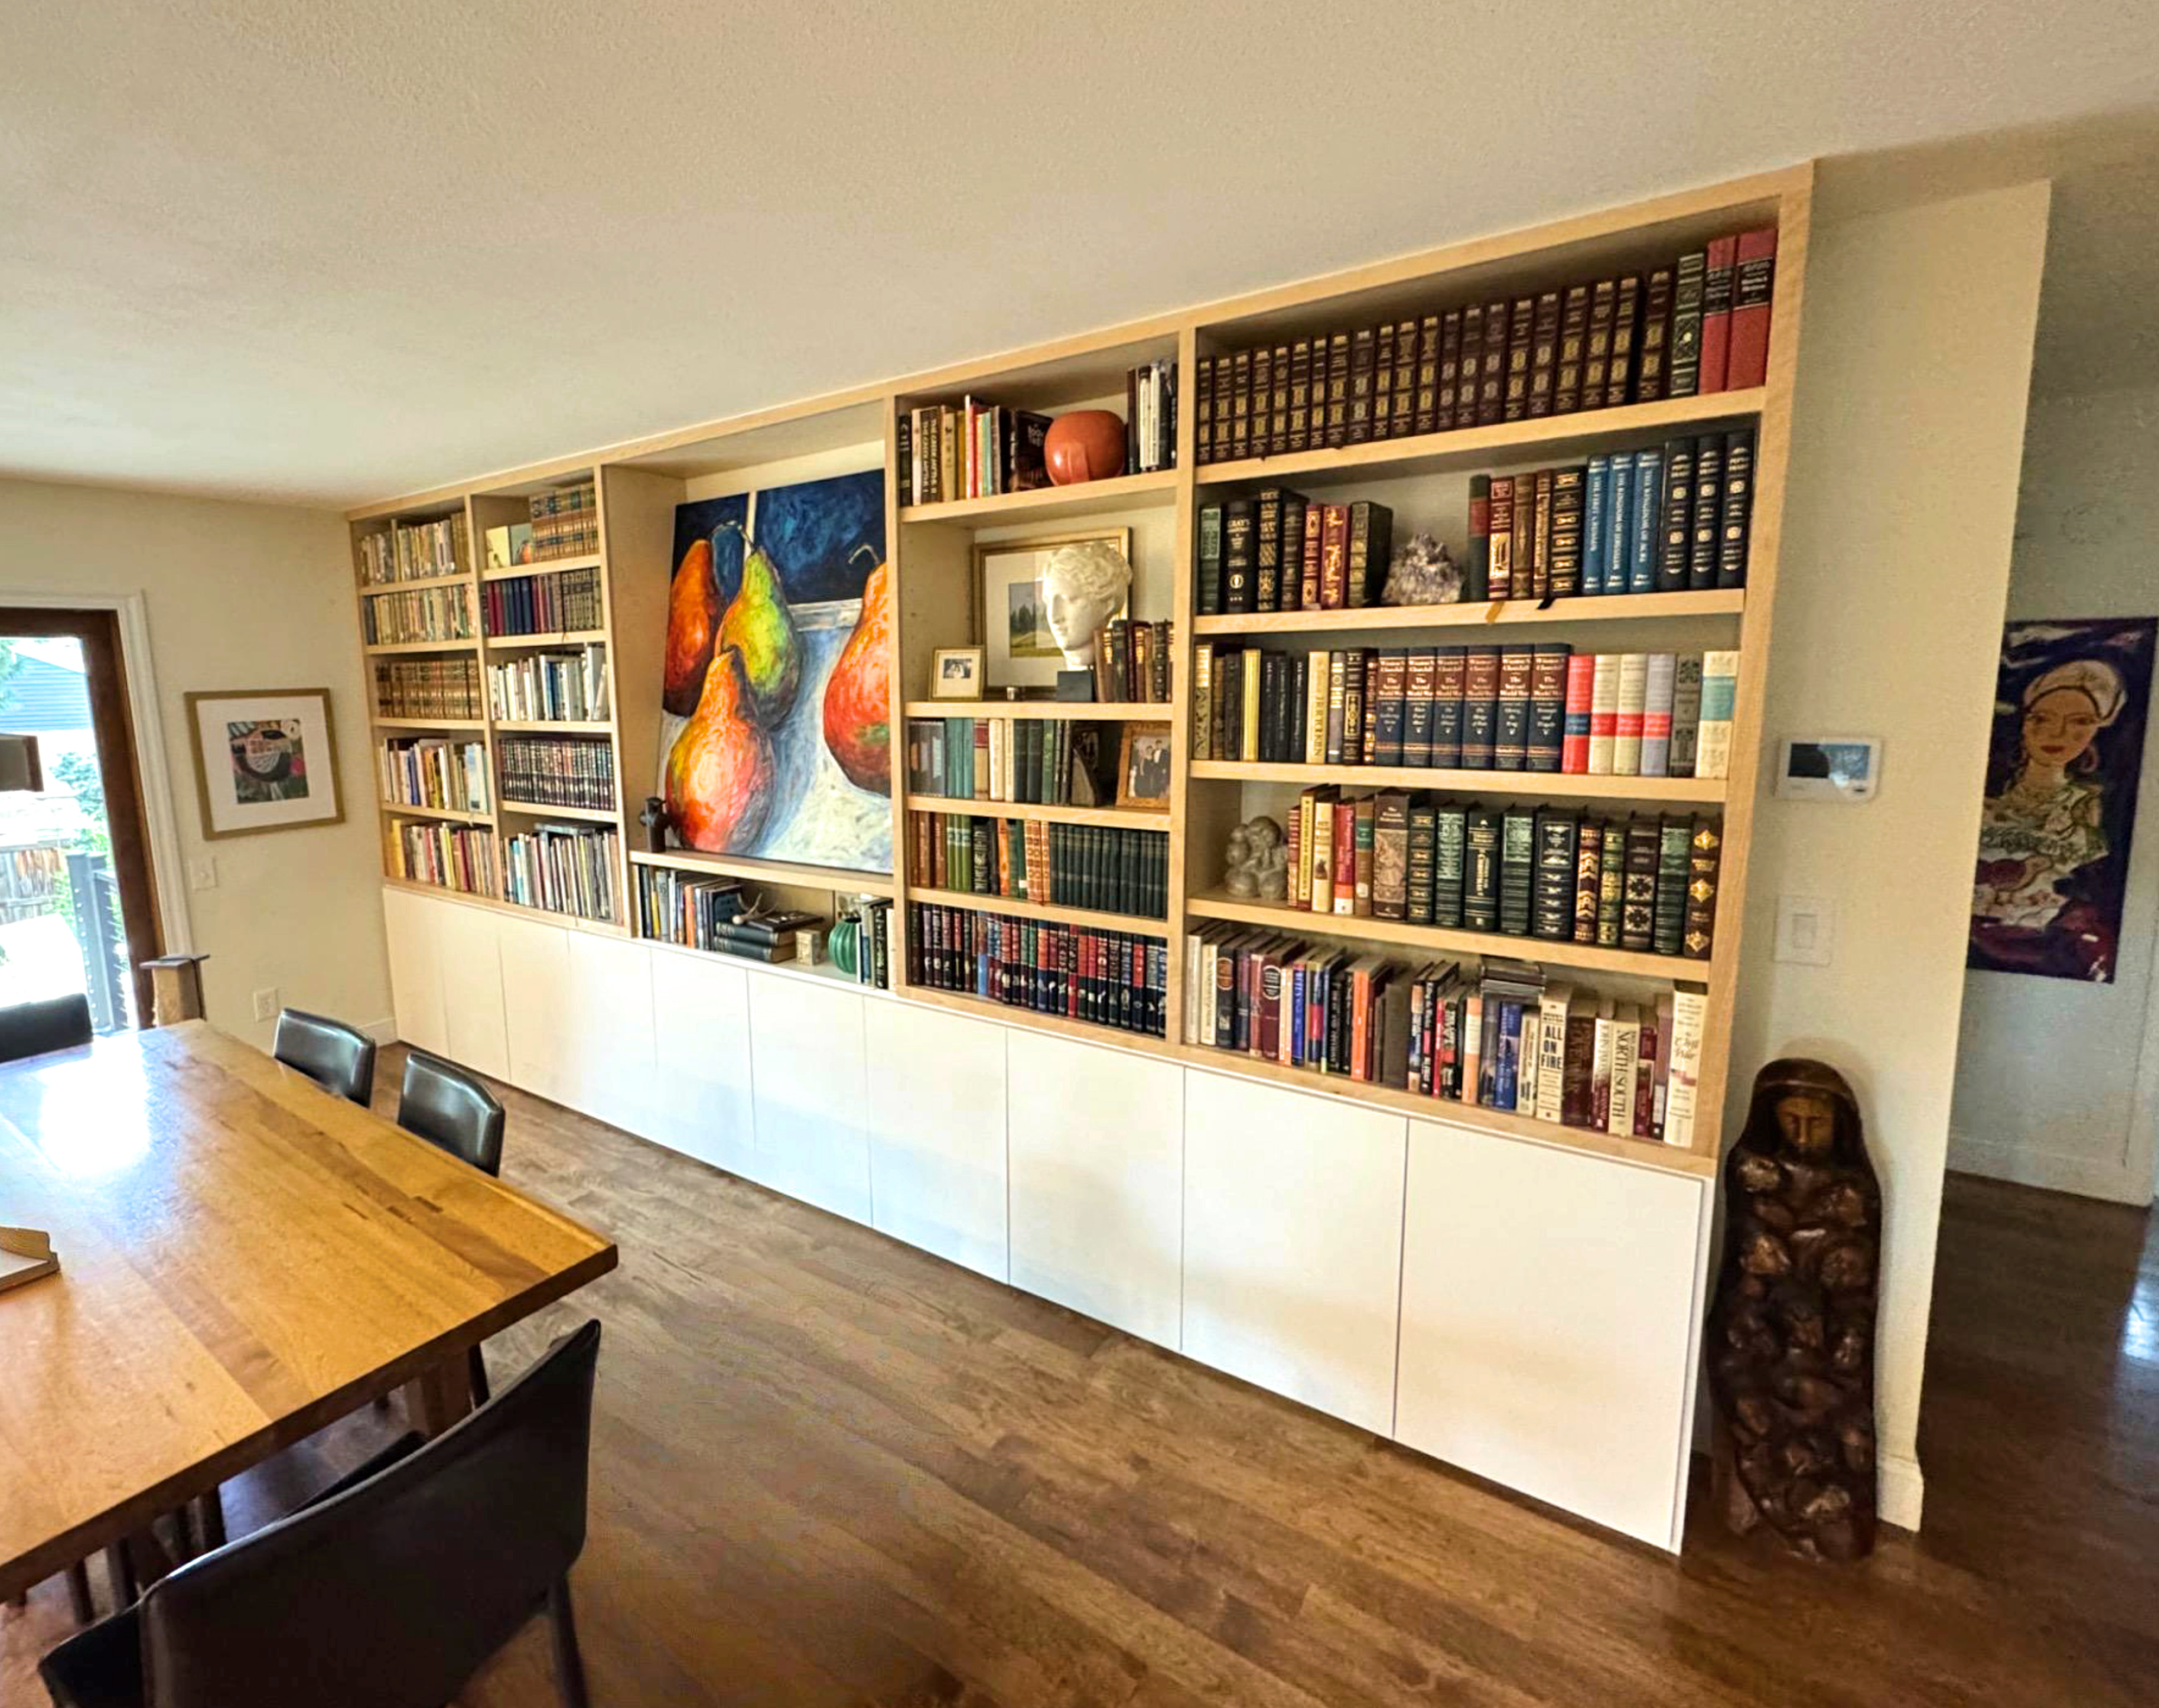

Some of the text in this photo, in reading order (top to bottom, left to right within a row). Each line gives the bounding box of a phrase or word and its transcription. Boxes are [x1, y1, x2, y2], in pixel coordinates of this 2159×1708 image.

[1314, 716, 1324, 756] TOLKIEN
[1545, 1025, 1562, 1041] ALL
[1543, 1040, 1557, 1053] ON
[1541, 1053, 1563, 1070] FIRE
[1611, 1030, 1630, 1118] NORTH SOUTH
